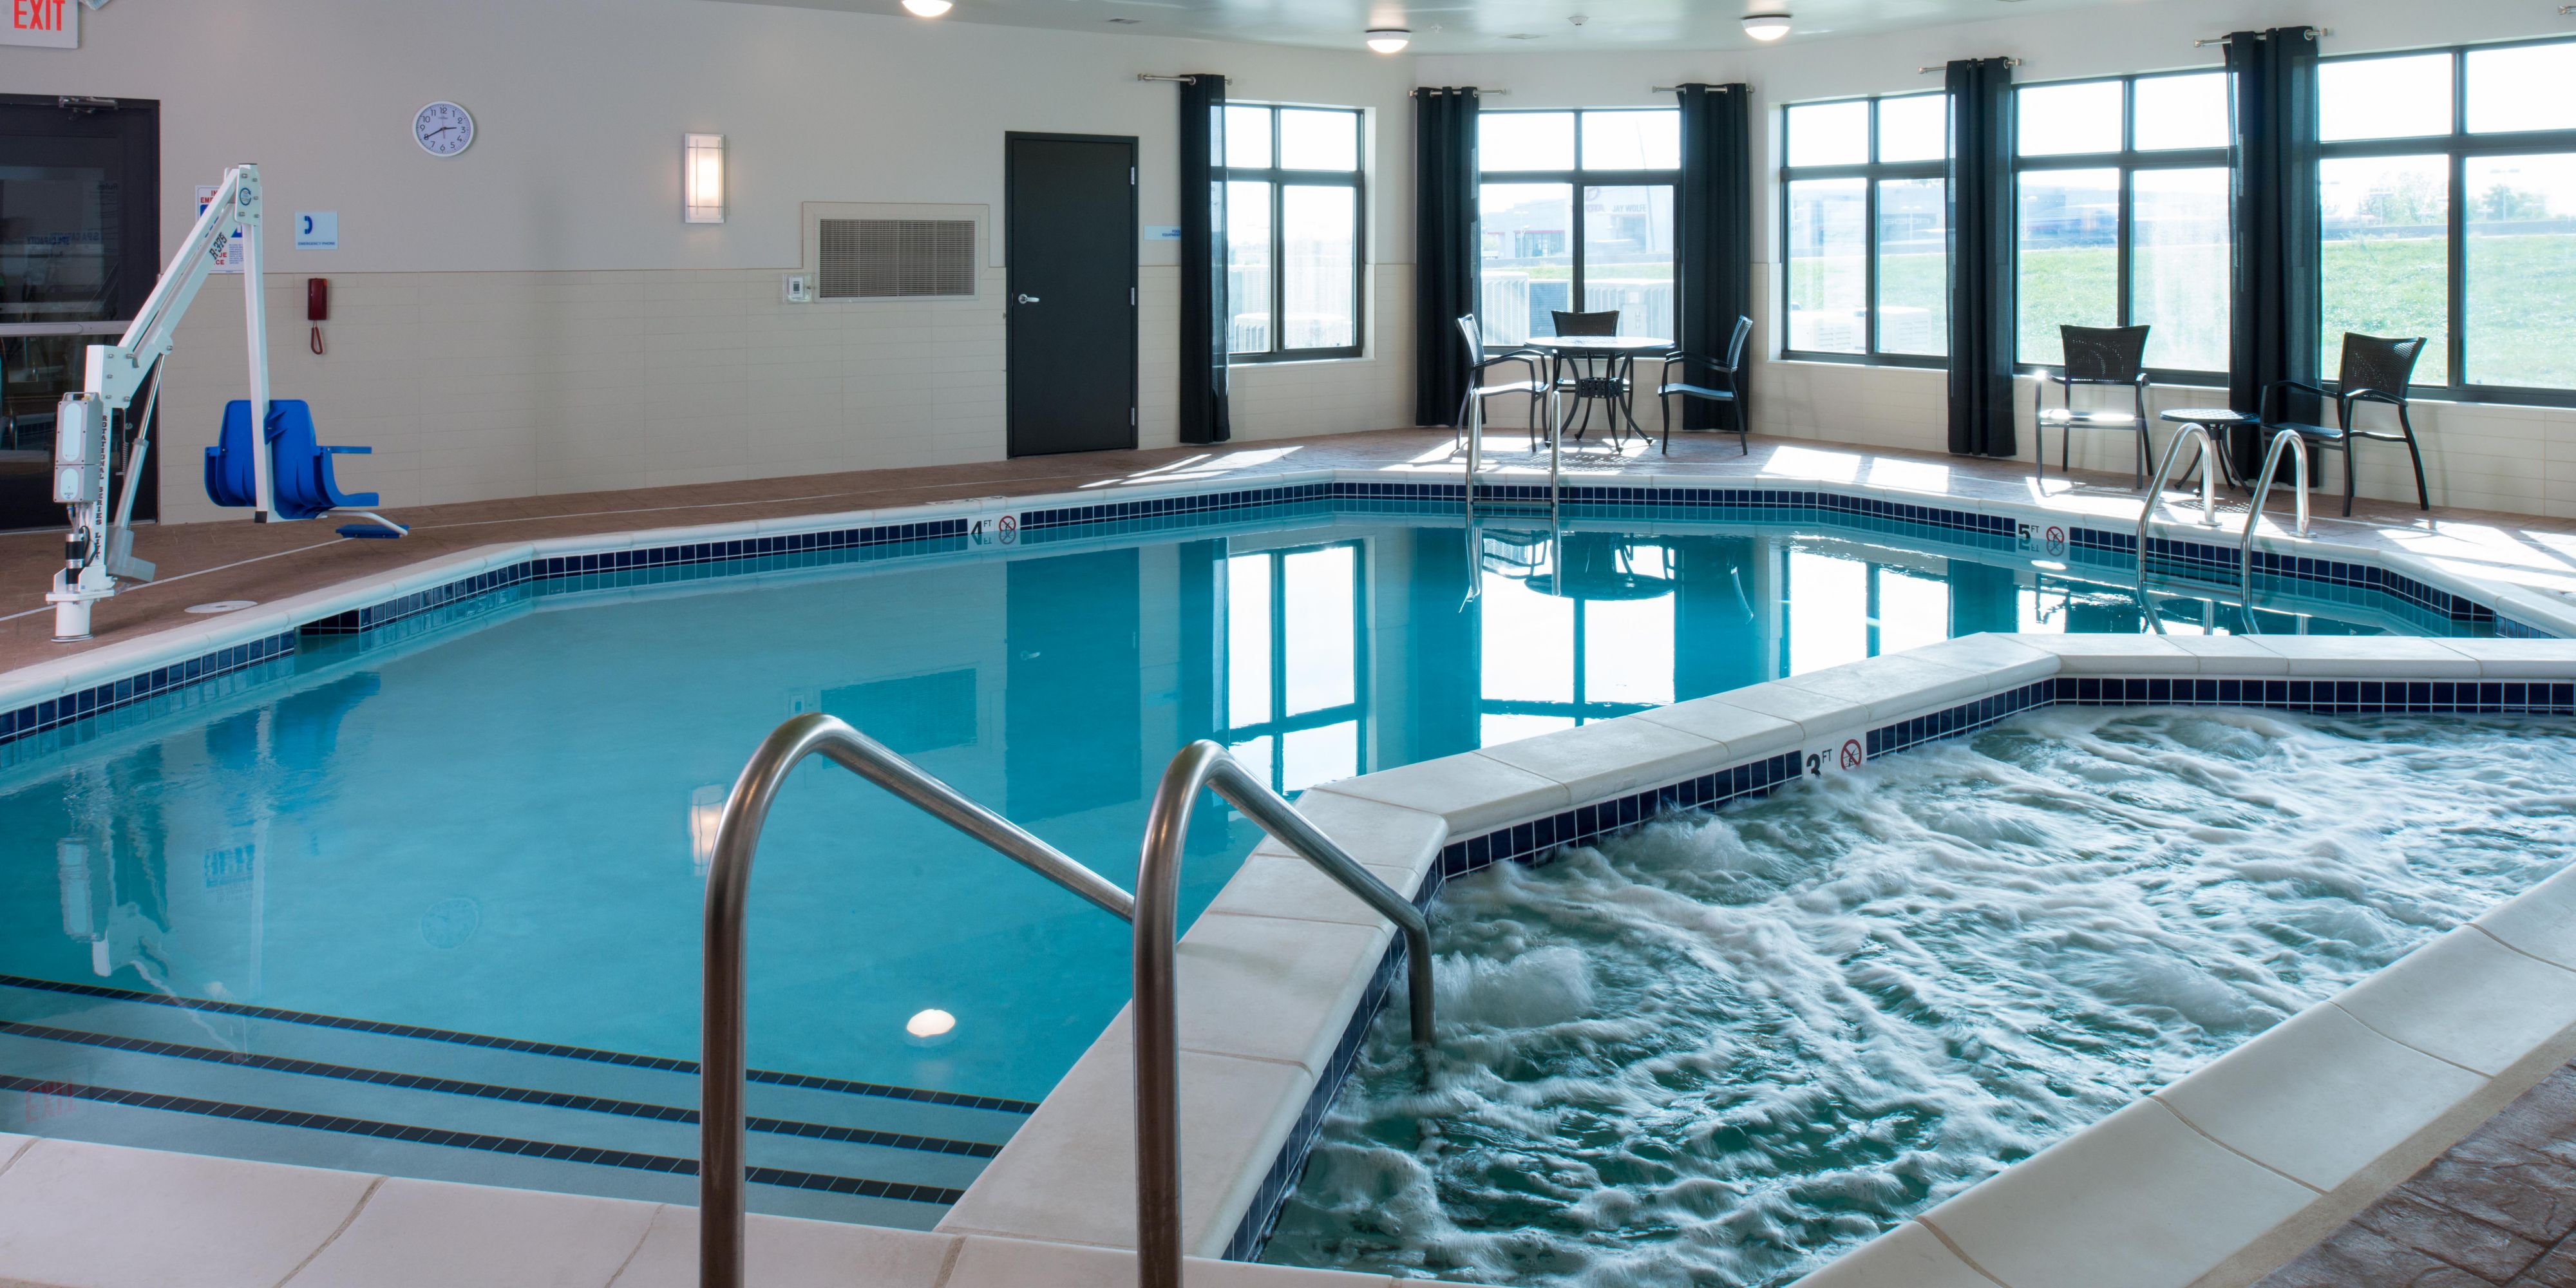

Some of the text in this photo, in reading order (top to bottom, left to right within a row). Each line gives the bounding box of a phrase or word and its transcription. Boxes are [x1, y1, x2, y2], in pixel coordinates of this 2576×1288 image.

[14, 0, 66, 31] EXIT
[971, 520, 982, 534] 4
[2018, 523, 2040, 538] 5 FT
[1822, 748, 1832, 764] FT
